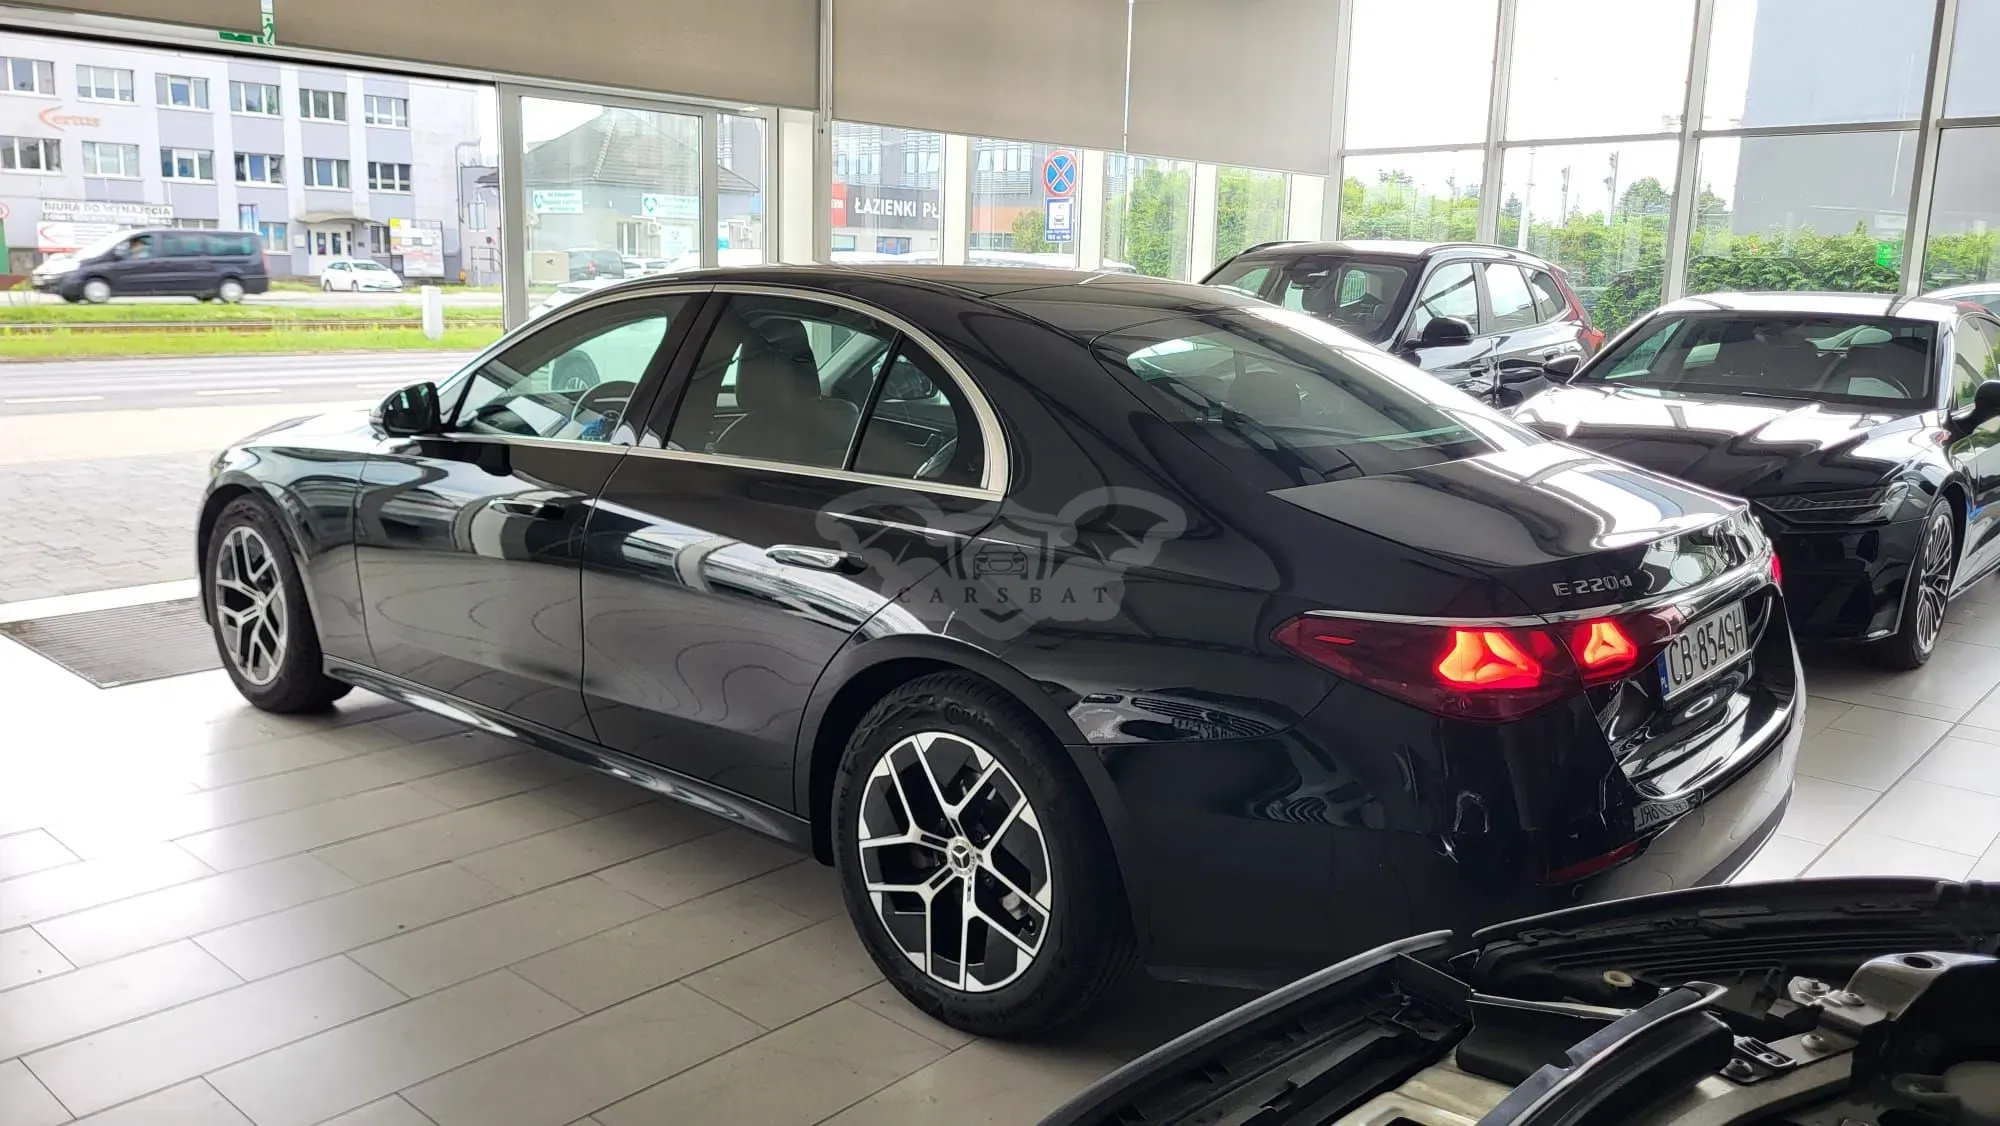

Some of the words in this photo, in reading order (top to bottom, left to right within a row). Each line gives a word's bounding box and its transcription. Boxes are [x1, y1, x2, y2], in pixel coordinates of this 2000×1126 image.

[44, 202, 81, 212] BIURA
[84, 203, 100, 213] DO
[854, 197, 917, 217] ŁAZIENKI
[1552, 582, 1572, 597] E
[1575, 575, 1633, 594] 220d
[1669, 635, 1694, 685] CB
[1697, 605, 1745, 670] 854SH
